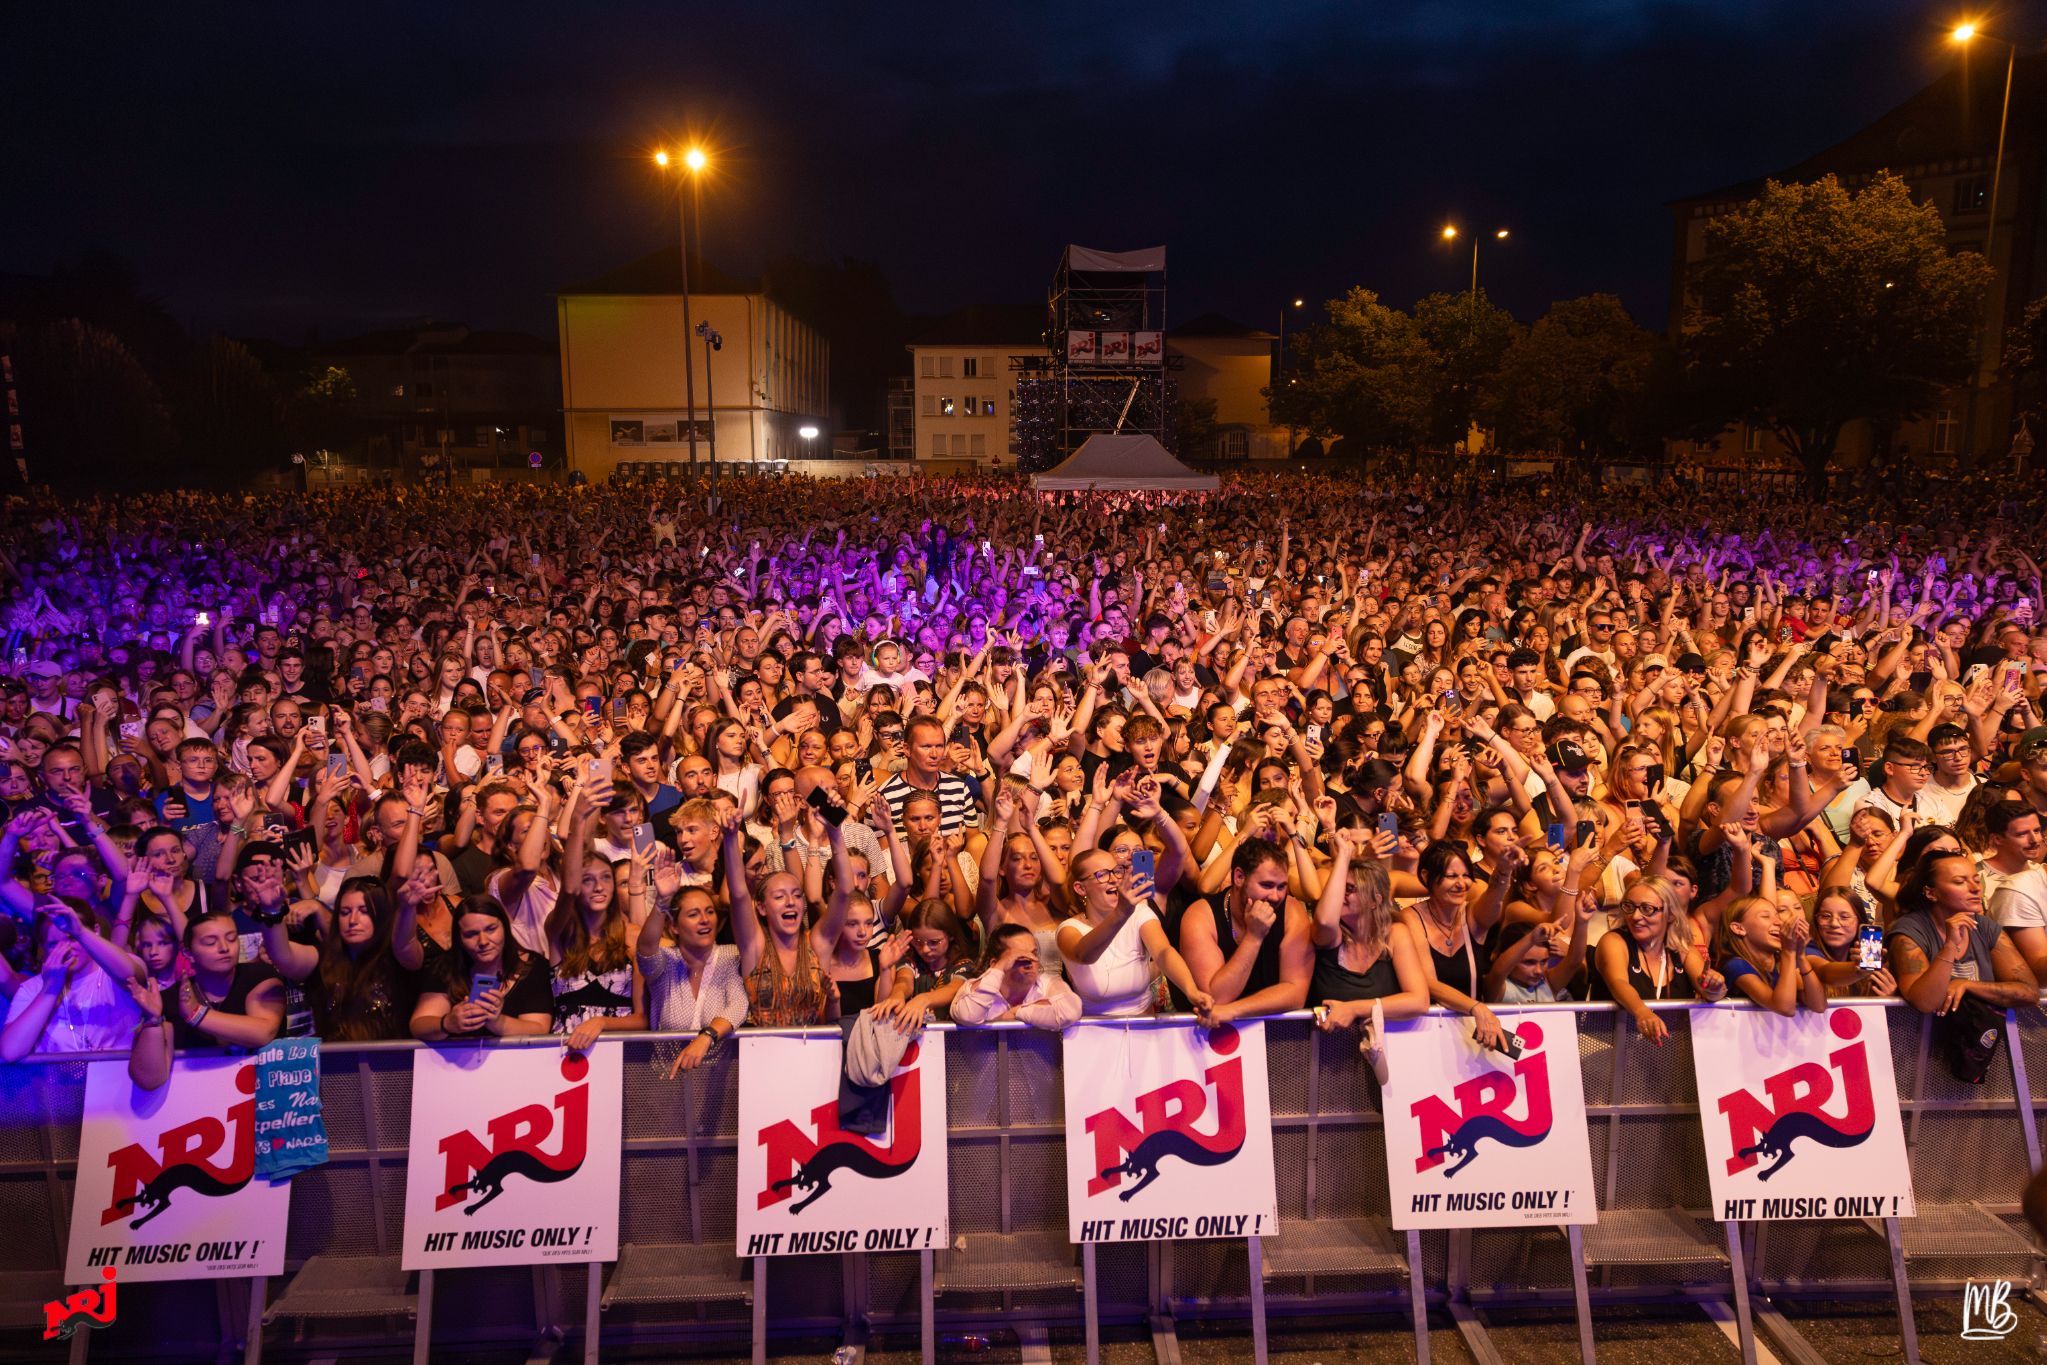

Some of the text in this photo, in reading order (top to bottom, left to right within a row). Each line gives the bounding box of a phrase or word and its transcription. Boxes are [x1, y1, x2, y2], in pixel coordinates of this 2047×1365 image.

[268, 1069, 312, 1088] Plage
[1411, 1194, 1441, 1212] HIT
[1446, 1191, 1505, 1211] MUSIC
[1511, 1191, 1558, 1209] ONLY
[1724, 1199, 1756, 1219] HIT
[1762, 1198, 1827, 1218] MUSIC
[1834, 1197, 1886, 1217] ONLY
[424, 1232, 458, 1252] HIT
[461, 1229, 525, 1250] MUSIC
[531, 1227, 580, 1247] ONLY
[1080, 1220, 1115, 1241] HIT
[1120, 1217, 1188, 1239] MUSIC
[1195, 1215, 1249, 1237] ONLY
[87, 1247, 122, 1267] HIT
[125, 1243, 191, 1265] MUSIC
[196, 1241, 248, 1261] ONLY
[747, 1234, 784, 1255] HIT
[788, 1230, 858, 1253] MUSIC
[864, 1228, 919, 1250] ONLY
